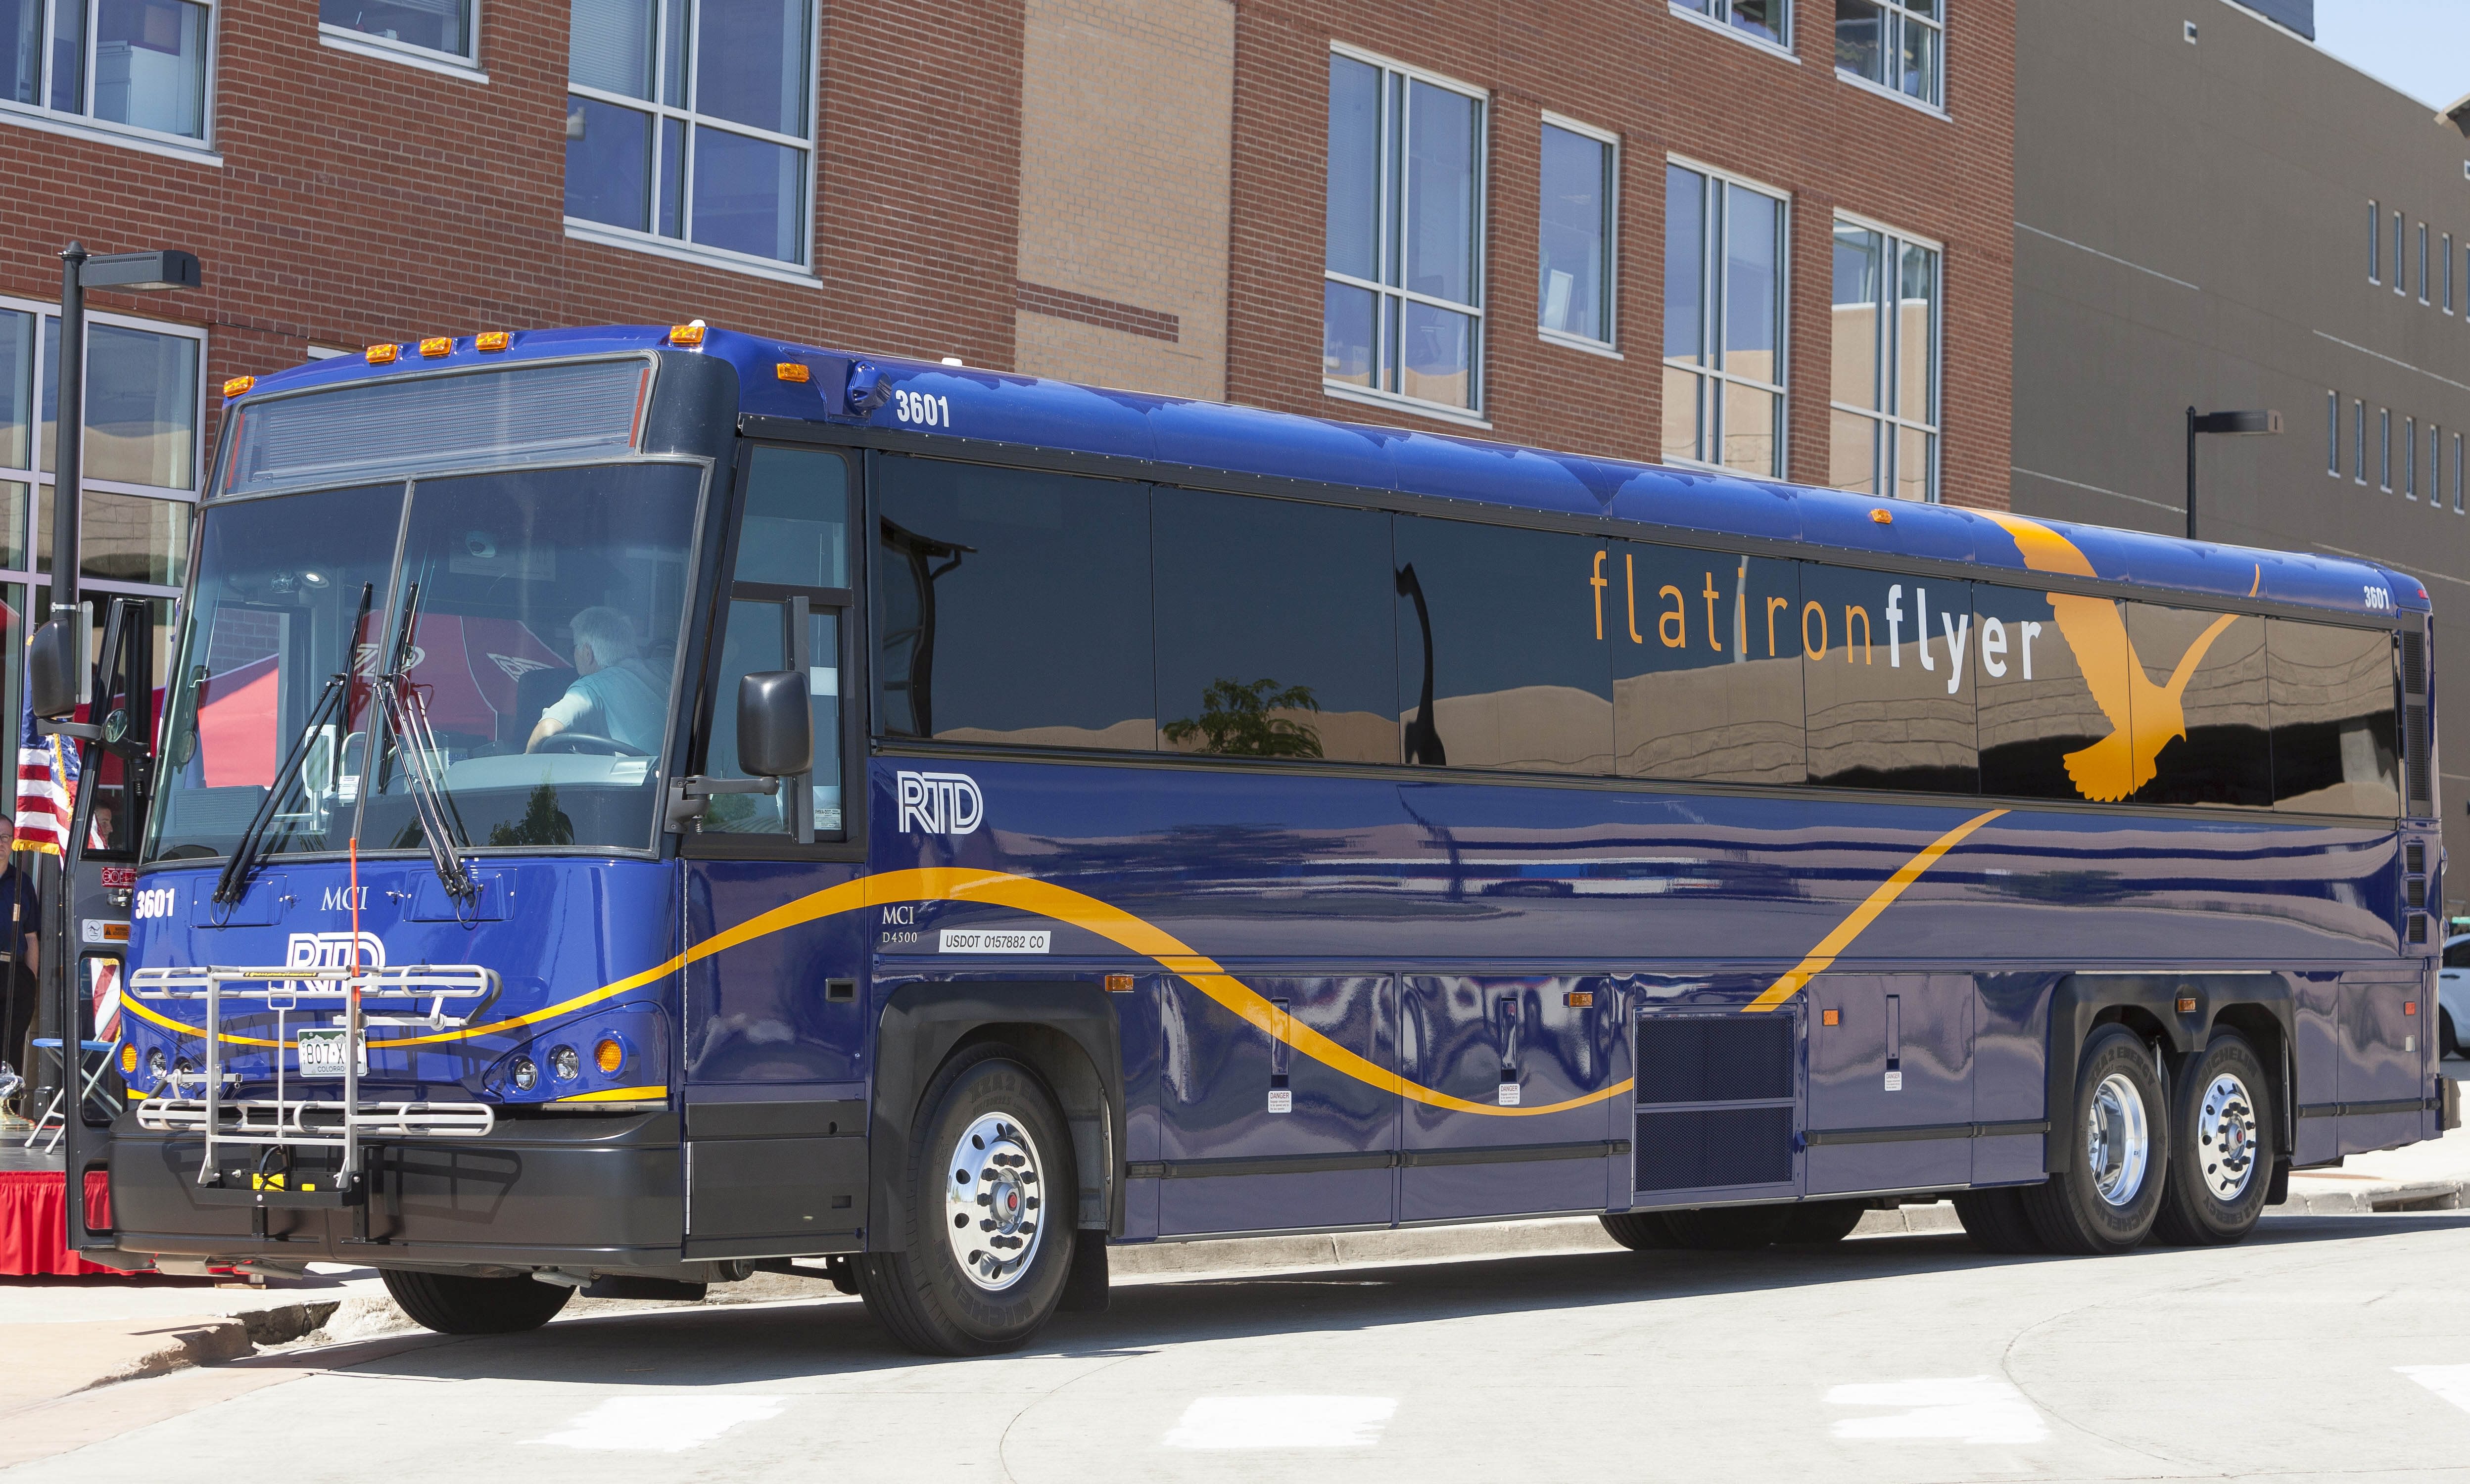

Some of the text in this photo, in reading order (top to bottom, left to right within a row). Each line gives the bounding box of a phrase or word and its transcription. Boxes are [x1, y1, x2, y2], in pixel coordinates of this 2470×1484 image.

[896, 390, 949, 427] 3601
[2364, 585, 2389, 610] 3601
[897, 771, 983, 835] RTD
[135, 888, 175, 919] 3601
[320, 886, 369, 911] MCI
[882, 906, 914, 925] MCI
[882, 932, 917, 943] D4500
[946, 935, 1044, 948] USDOT 0157882 CO
[284, 931, 386, 992] RTD
[2196, 1046, 2257, 1093] MICHELIN
[2091, 1193, 2155, 1232] MICHELIN
[934, 1239, 1034, 1327] MICHELIN
